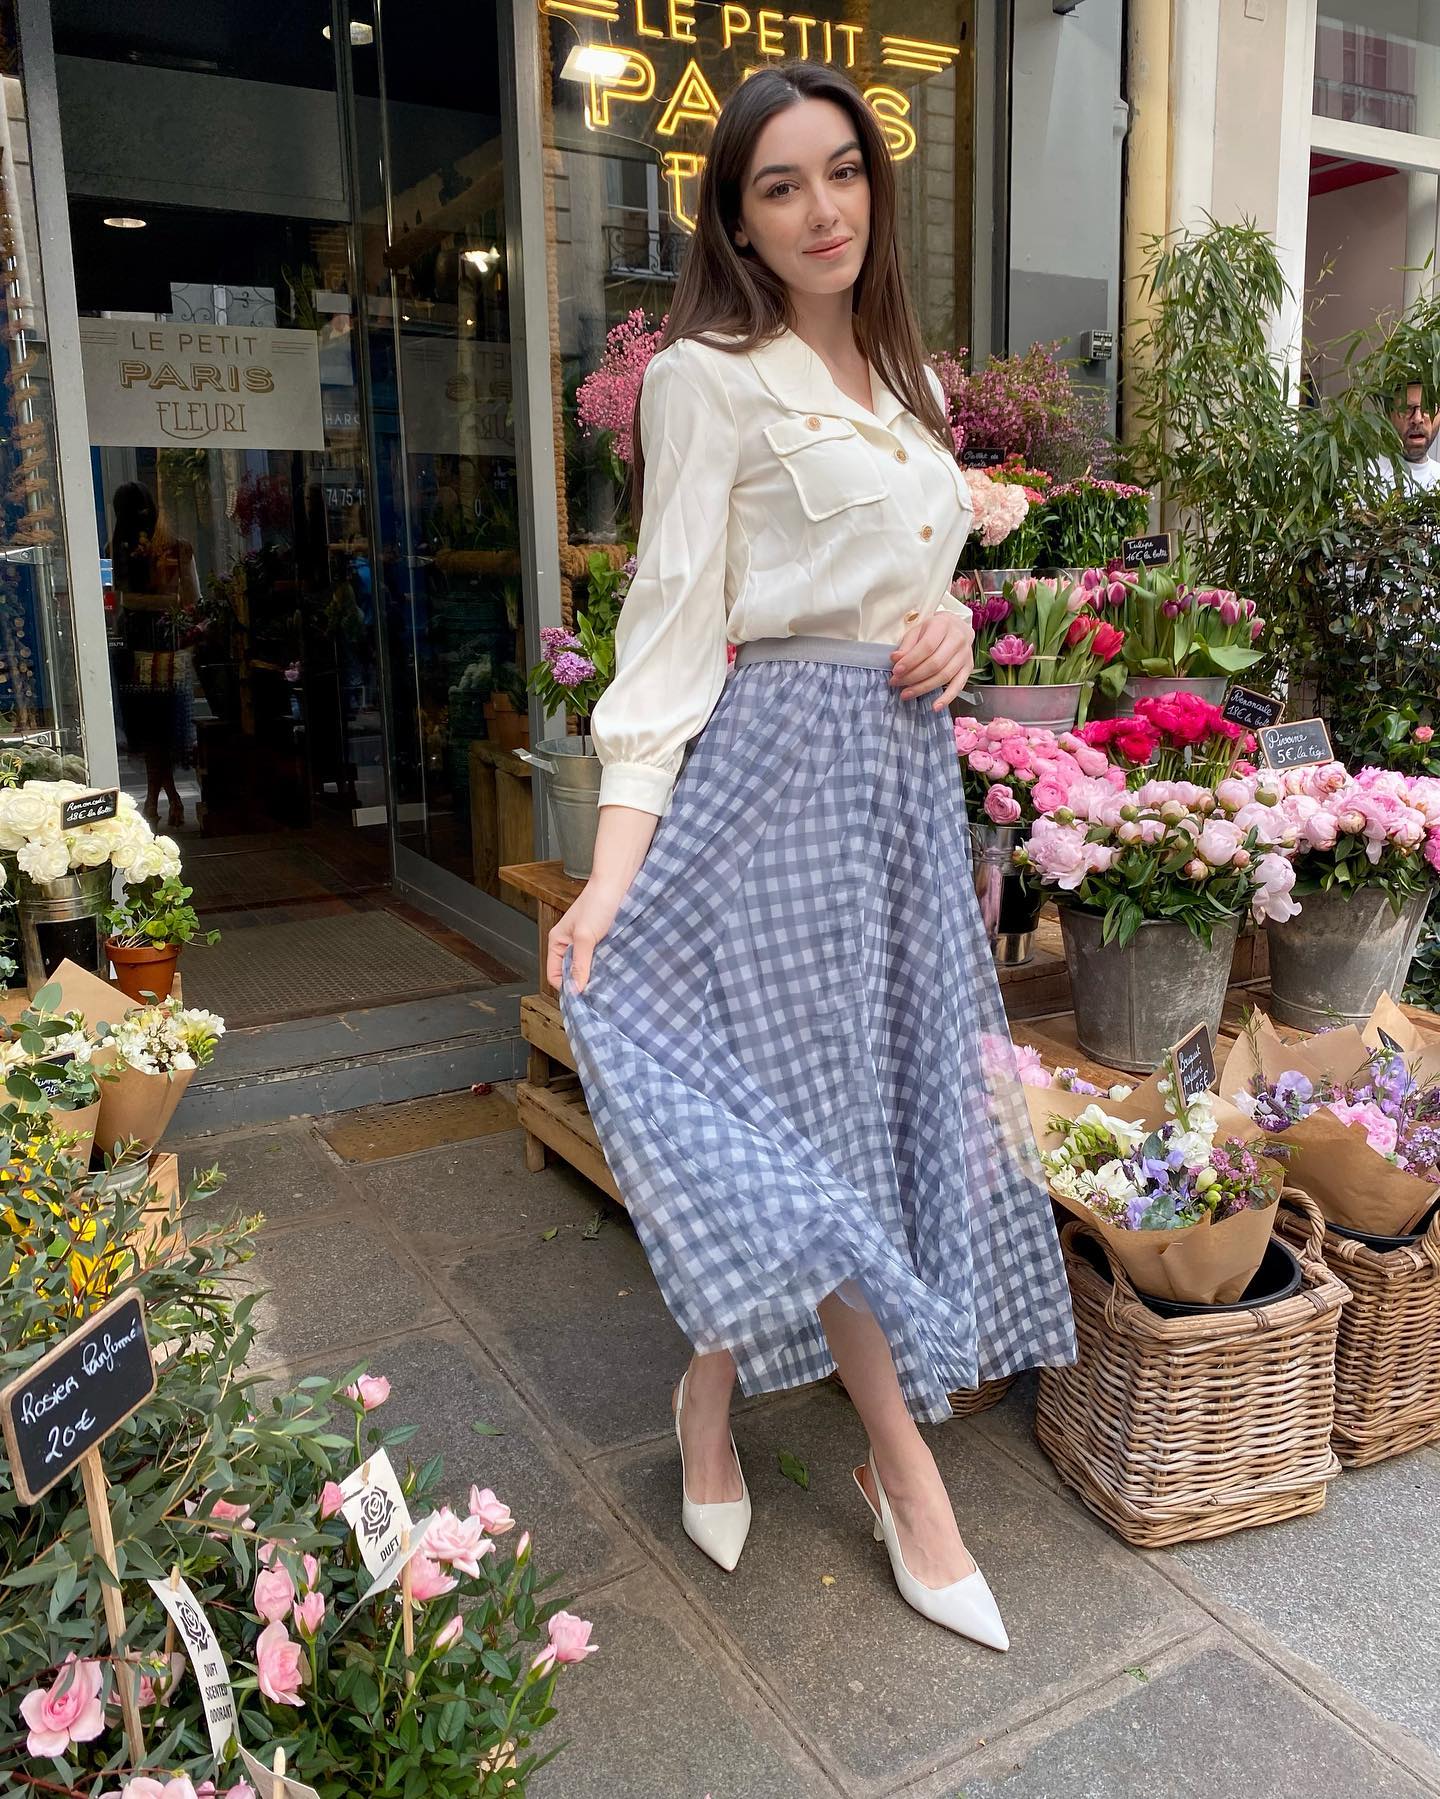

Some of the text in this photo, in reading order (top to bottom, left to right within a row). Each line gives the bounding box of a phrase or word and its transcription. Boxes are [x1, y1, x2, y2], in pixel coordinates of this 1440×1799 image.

[635, 0, 865, 68] LE PETIT
[588, 43, 917, 161] PAS
[131, 330, 258, 355] LE PETIT
[118, 359, 275, 393] PARIS
[155, 401, 248, 440] FLEURI
[21, 1317, 138, 1425] Rosier Parfumé
[44, 1408, 96, 1464] 20€
[380, 1535, 401, 1562] DUFT
[203, 1662, 218, 1678] DUFT
[205, 1682, 228, 1701] SCENTED
[210, 1703, 233, 1724] ODORANT
